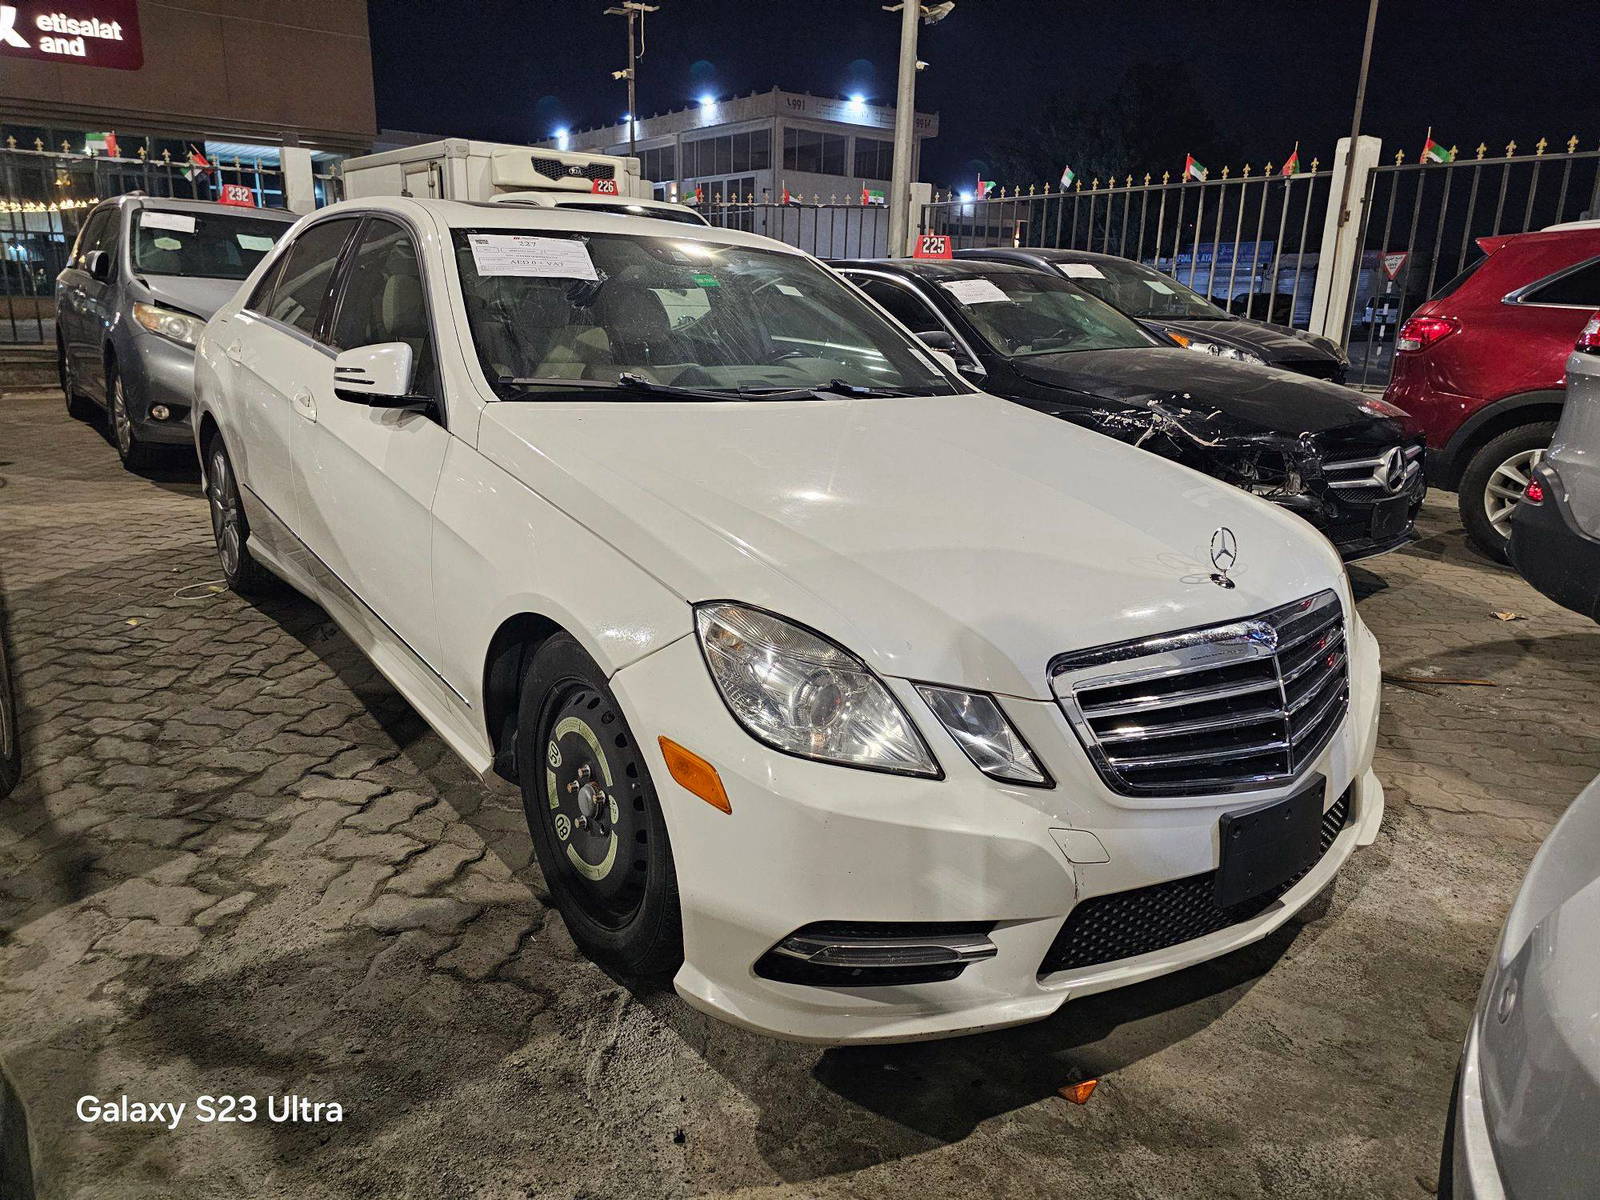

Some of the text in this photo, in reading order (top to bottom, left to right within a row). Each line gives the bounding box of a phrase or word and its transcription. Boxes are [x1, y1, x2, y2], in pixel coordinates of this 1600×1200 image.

[36, 12, 124, 41] etisalat
[39, 36, 86, 57] and
[228, 186, 249, 202] 232
[597, 180, 614, 193] 226
[922, 237, 945, 254] 225
